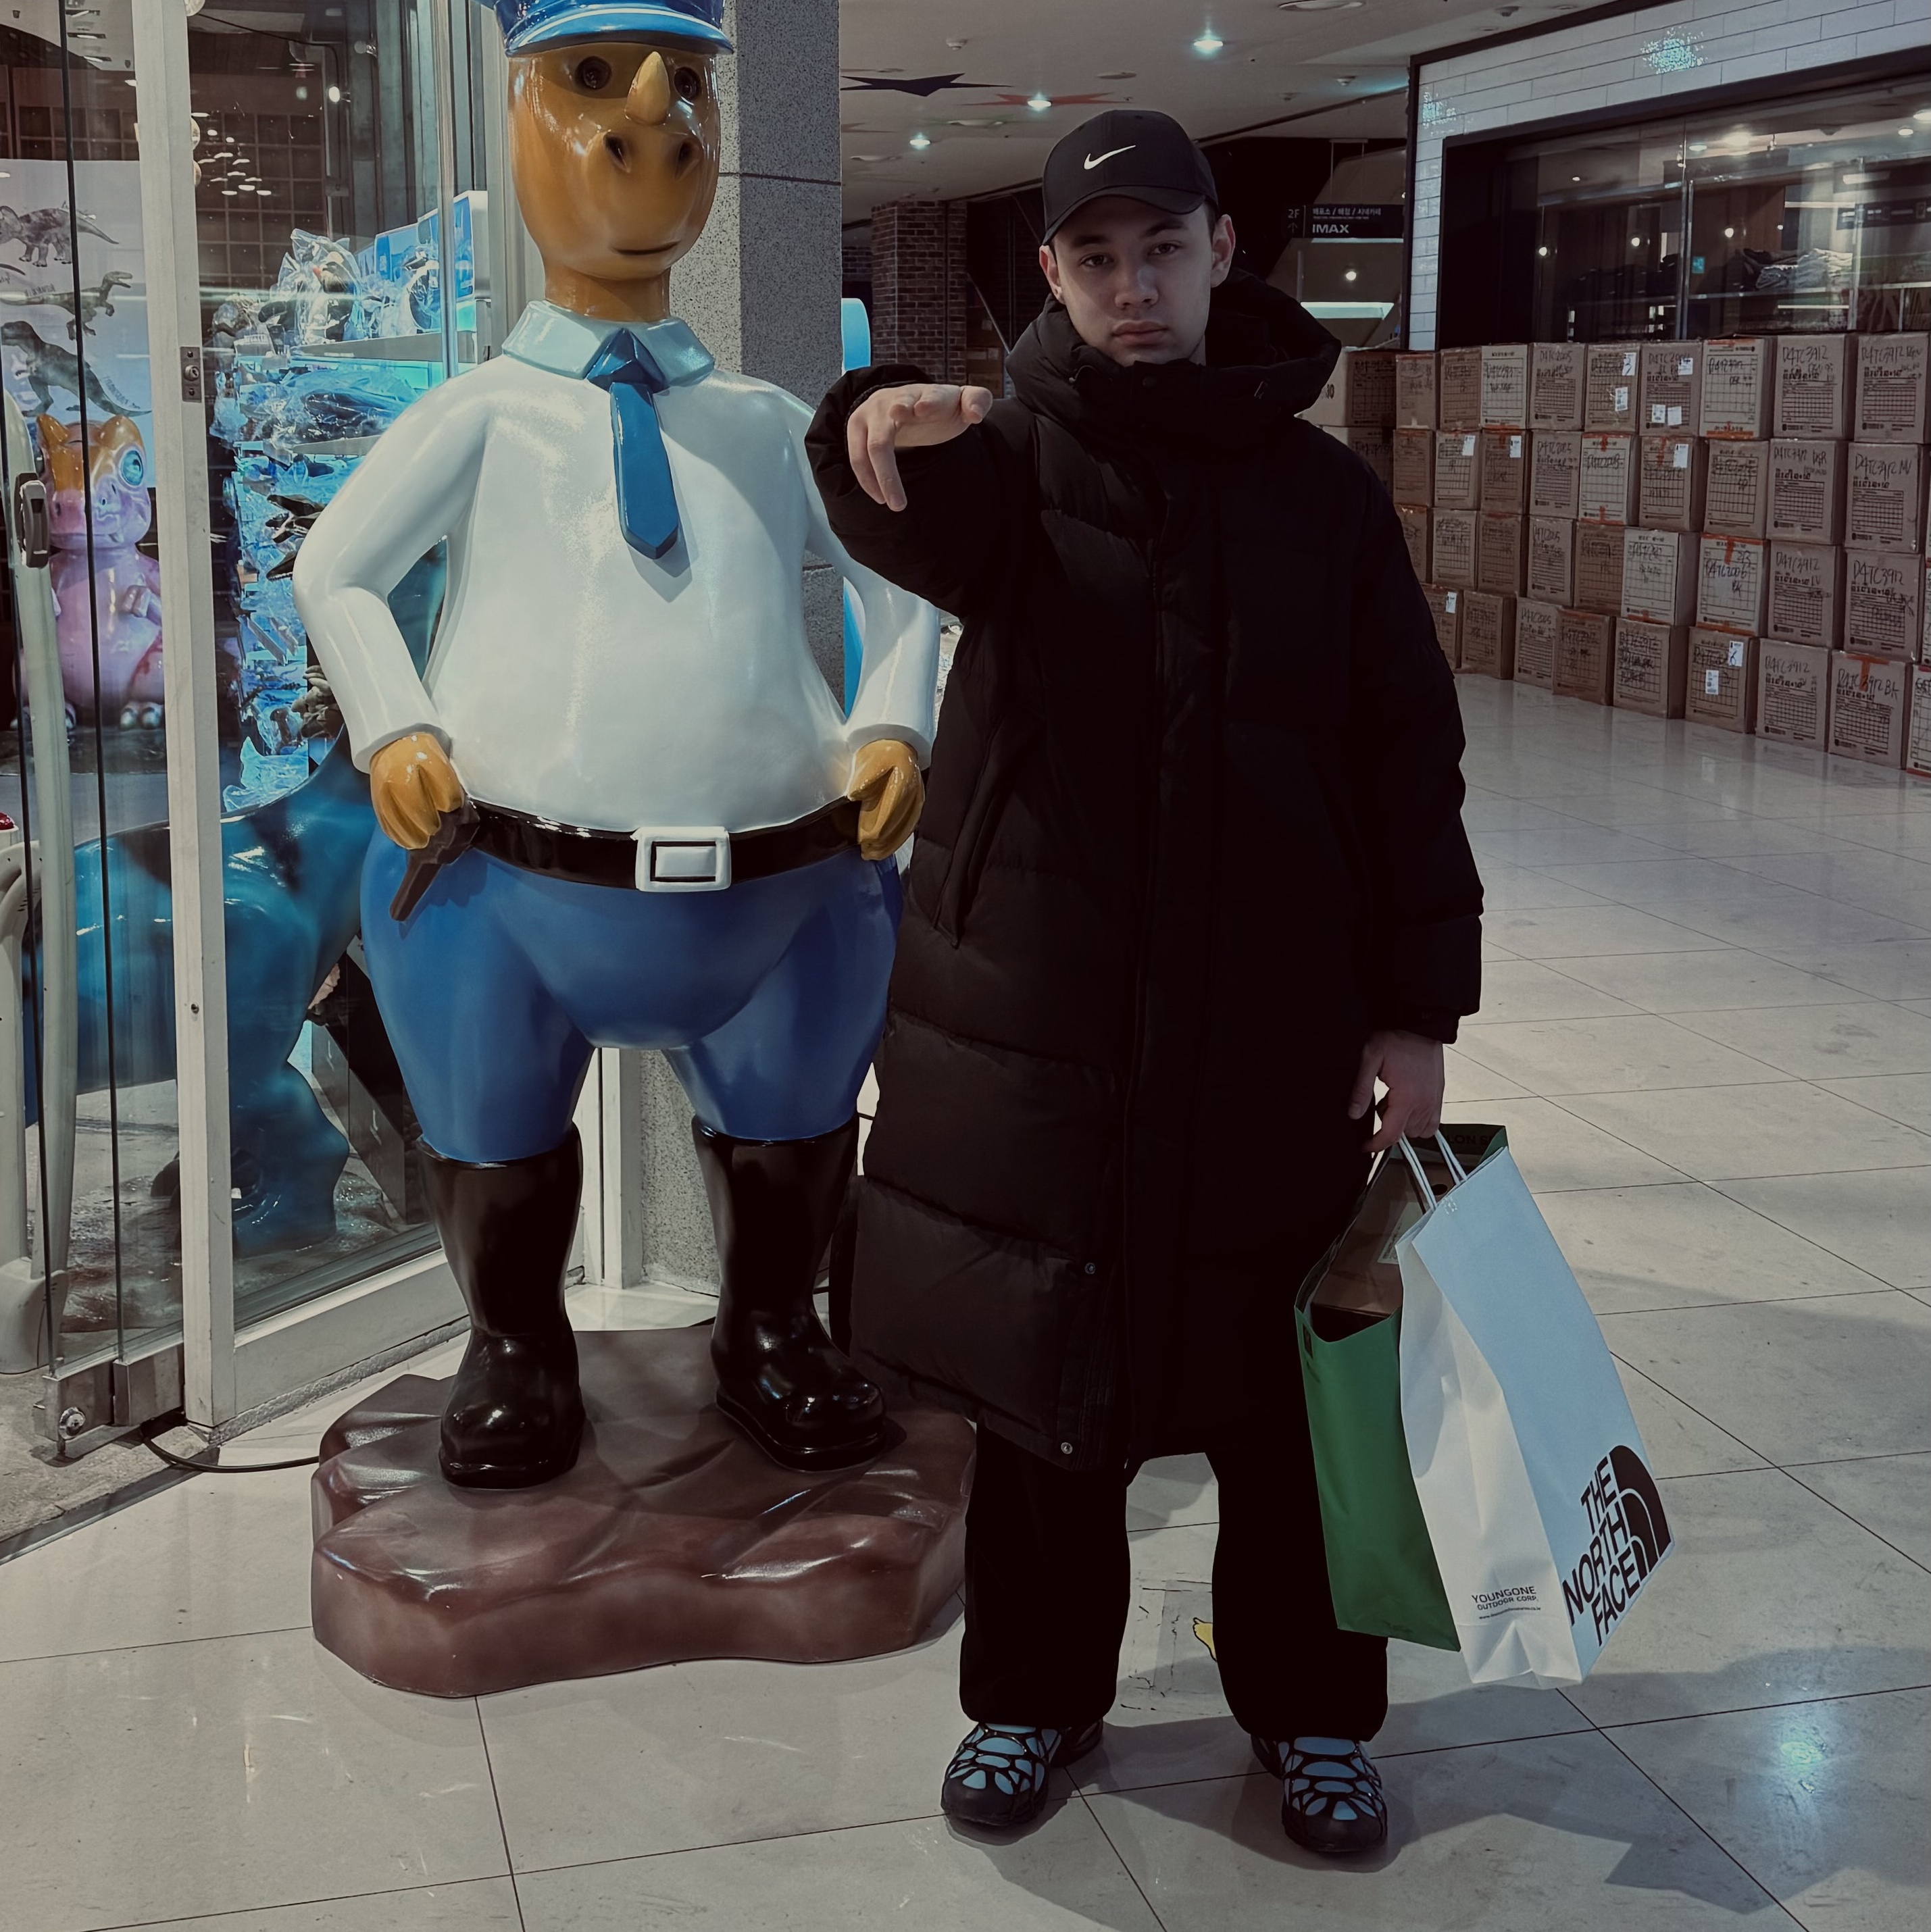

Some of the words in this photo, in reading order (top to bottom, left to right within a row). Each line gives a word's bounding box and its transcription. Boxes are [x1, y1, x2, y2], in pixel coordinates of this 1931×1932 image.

[1288, 209, 1300, 219] 2F
[1313, 207, 1330, 215] 매표소
[1312, 224, 1349, 233] IMAX
[1580, 1456, 1617, 1534] THE
[1562, 1501, 1629, 1627] NORTH
[1472, 1586, 1536, 1603] YOUNGONE
[1591, 1548, 1640, 1647] FACE
[1477, 1597, 1514, 1610] OUTDOOR
